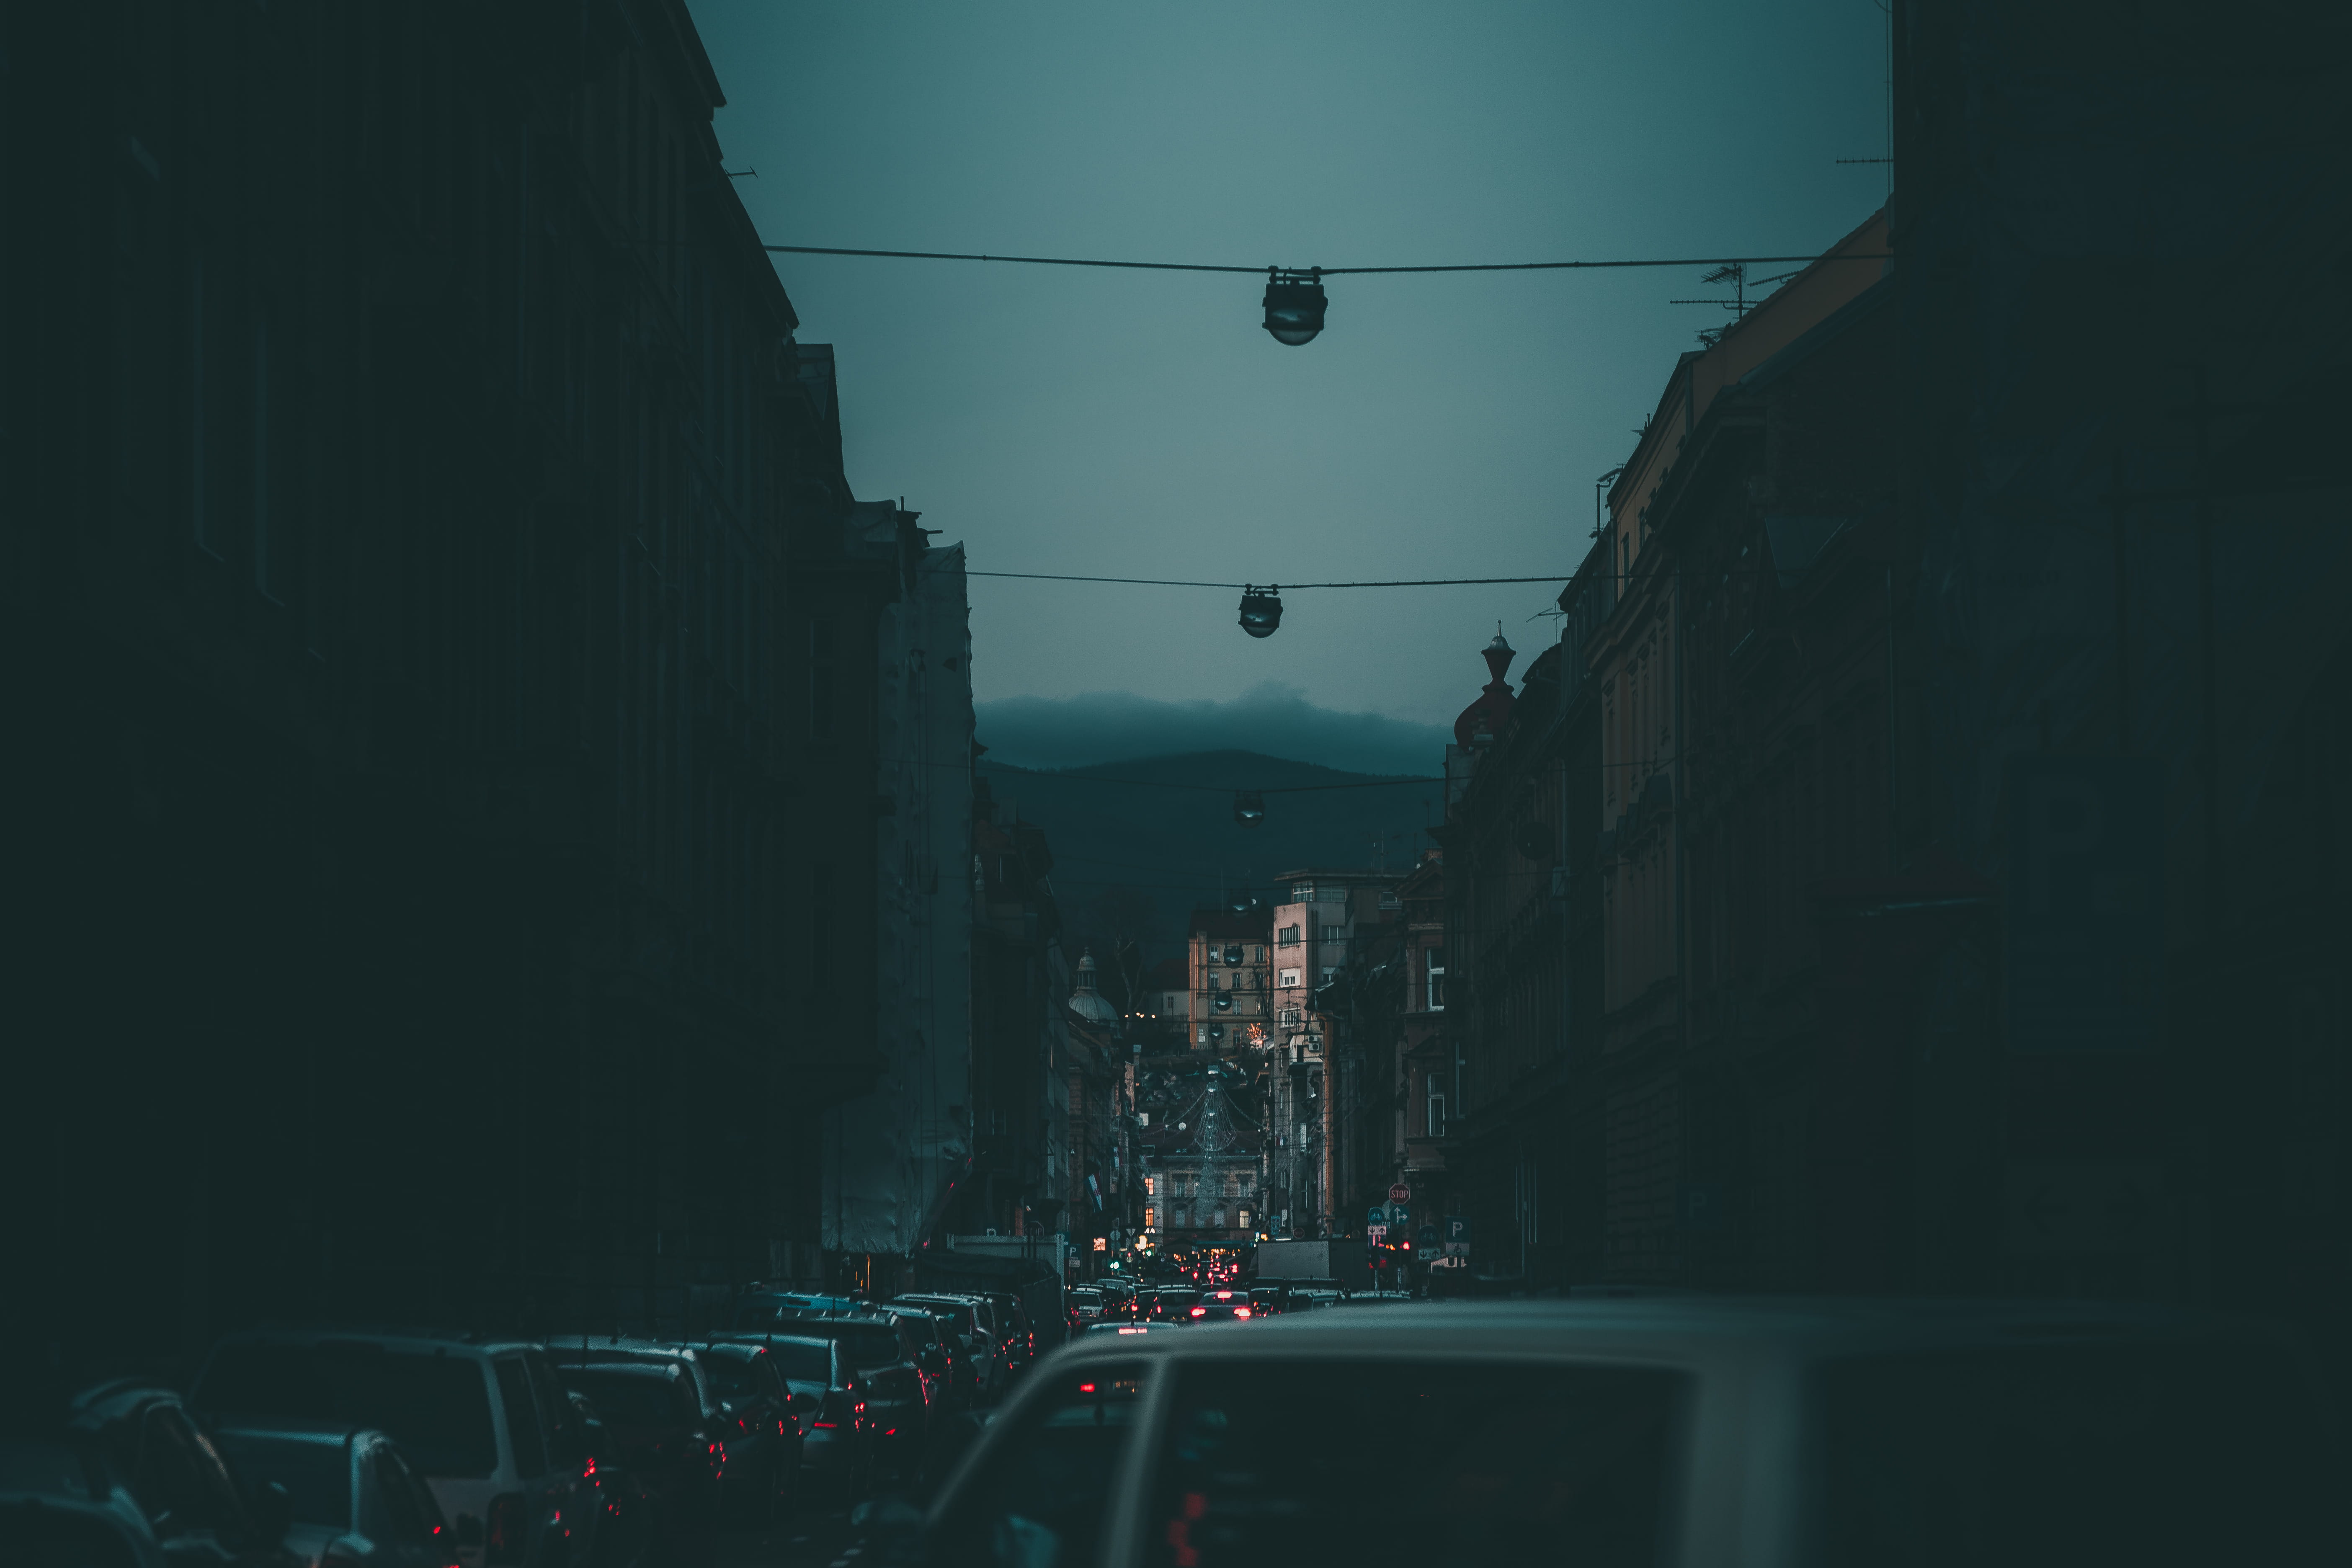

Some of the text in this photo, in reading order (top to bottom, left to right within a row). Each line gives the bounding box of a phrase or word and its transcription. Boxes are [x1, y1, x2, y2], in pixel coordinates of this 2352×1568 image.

[1390, 1189, 1408, 1198] STOP
[1453, 1221, 1463, 1237] P
[1070, 1247, 1076, 1257] P
